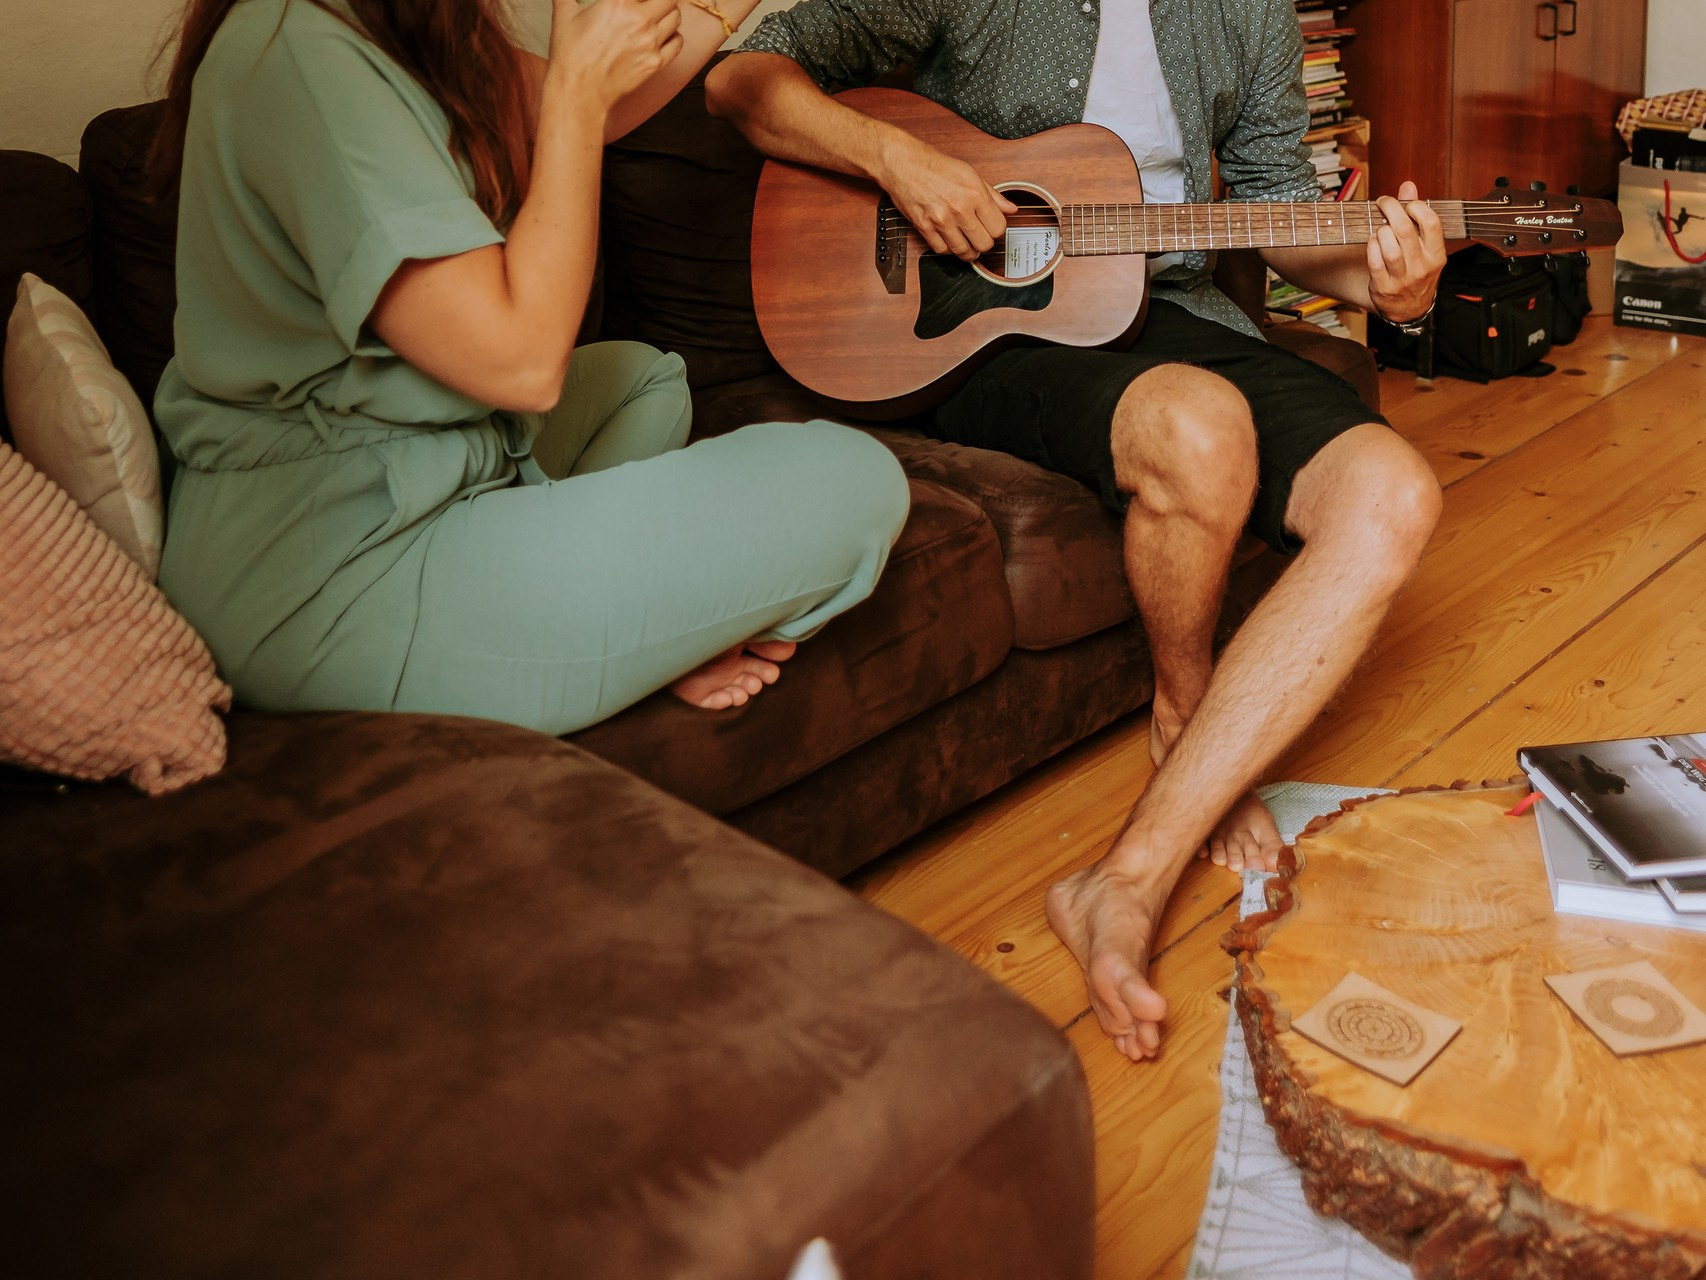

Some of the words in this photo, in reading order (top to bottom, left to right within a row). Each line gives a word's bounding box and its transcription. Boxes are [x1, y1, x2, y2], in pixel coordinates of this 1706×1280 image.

[1514, 216, 1544, 226] Harley
[1546, 215, 1574, 224] Benton
[1622, 295, 1663, 310] Canon
